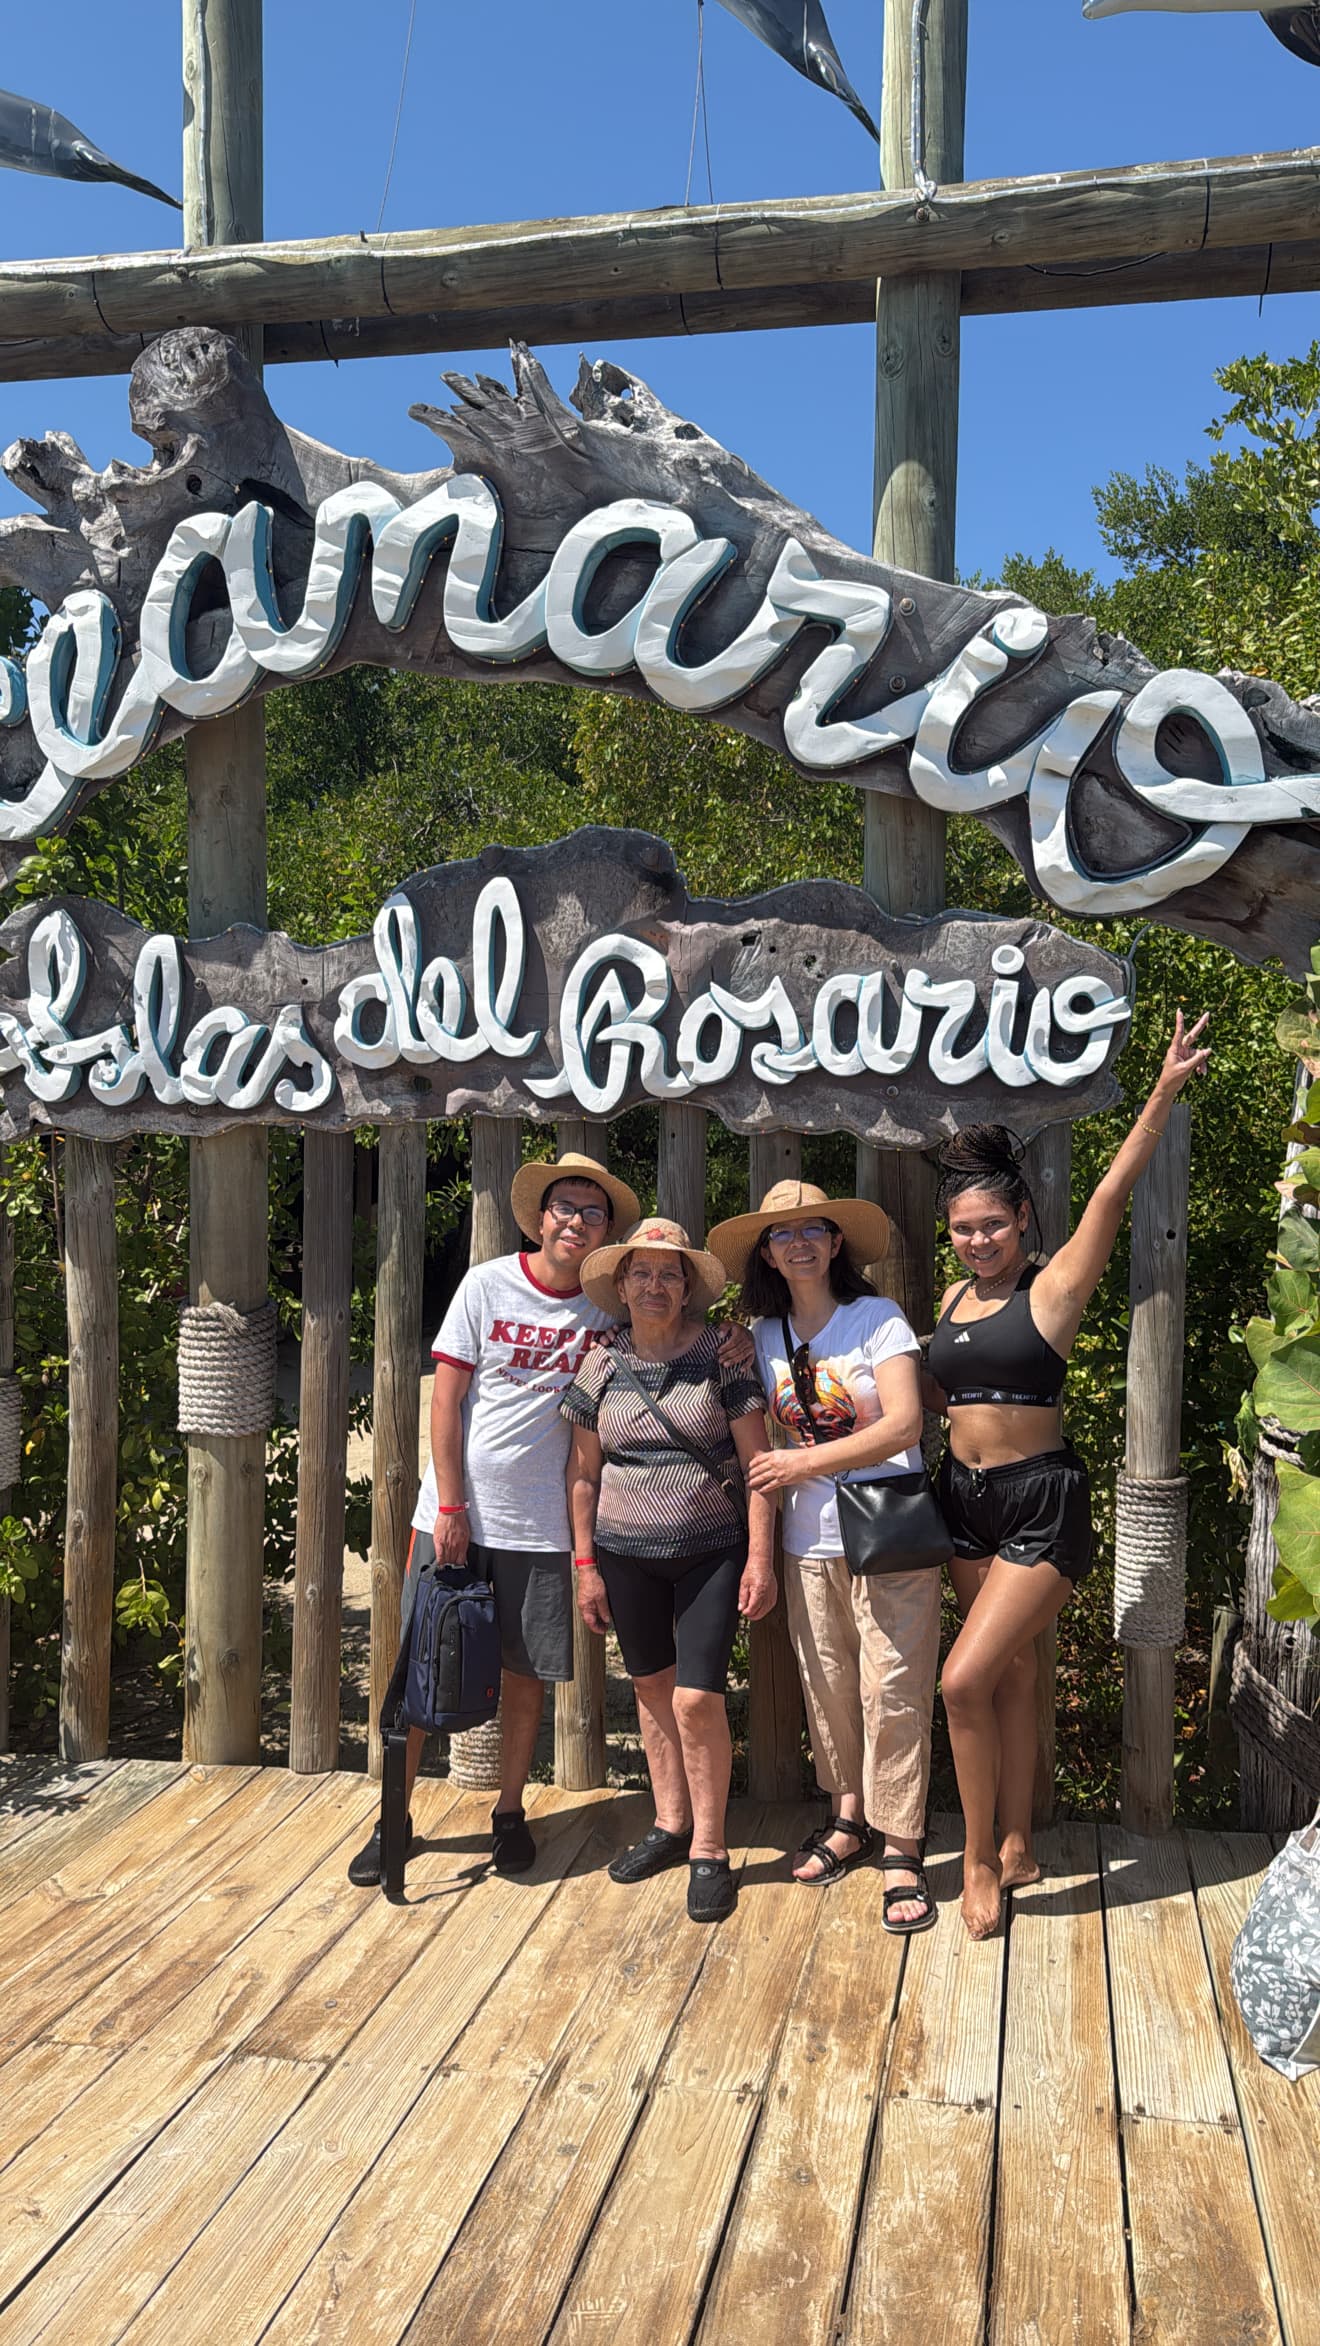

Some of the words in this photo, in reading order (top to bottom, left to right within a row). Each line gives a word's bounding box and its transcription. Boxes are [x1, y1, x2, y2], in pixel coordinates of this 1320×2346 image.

[0, 474, 1320, 915] eanario
[334, 876, 541, 1069] del
[523, 933, 1131, 1113] Rosario
[488, 1319, 577, 1350] KEEP
